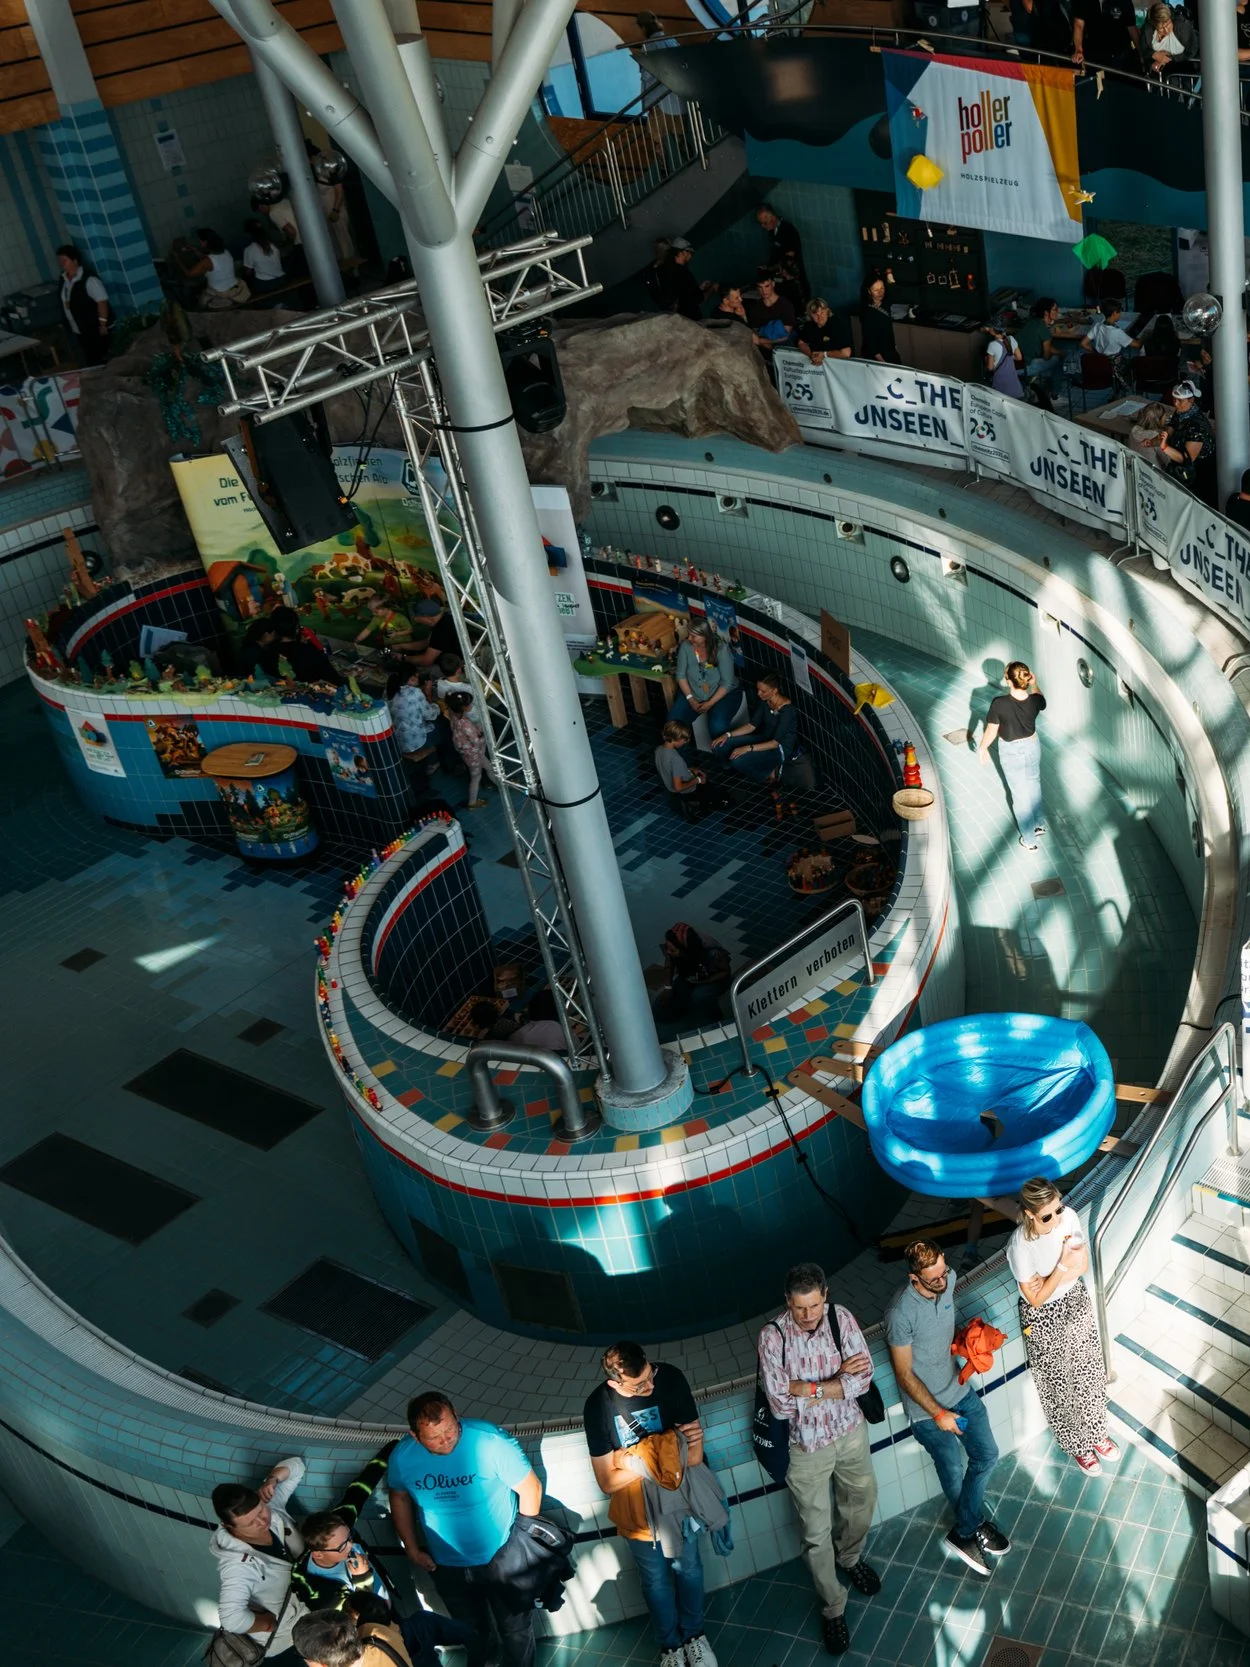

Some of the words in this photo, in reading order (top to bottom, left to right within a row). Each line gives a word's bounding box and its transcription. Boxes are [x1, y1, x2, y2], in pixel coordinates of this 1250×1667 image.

[958, 90, 1011, 131] holler
[961, 122, 1012, 164] poller
[960, 173, 1020, 187] HOLZSPIELZEUG
[219, 477, 239, 488] Die
[213, 496, 239, 506] vom
[747, 975, 798, 1019] Klettern
[806, 933, 855, 976] verboten
[415, 1473, 477, 1490] s.Oliver
